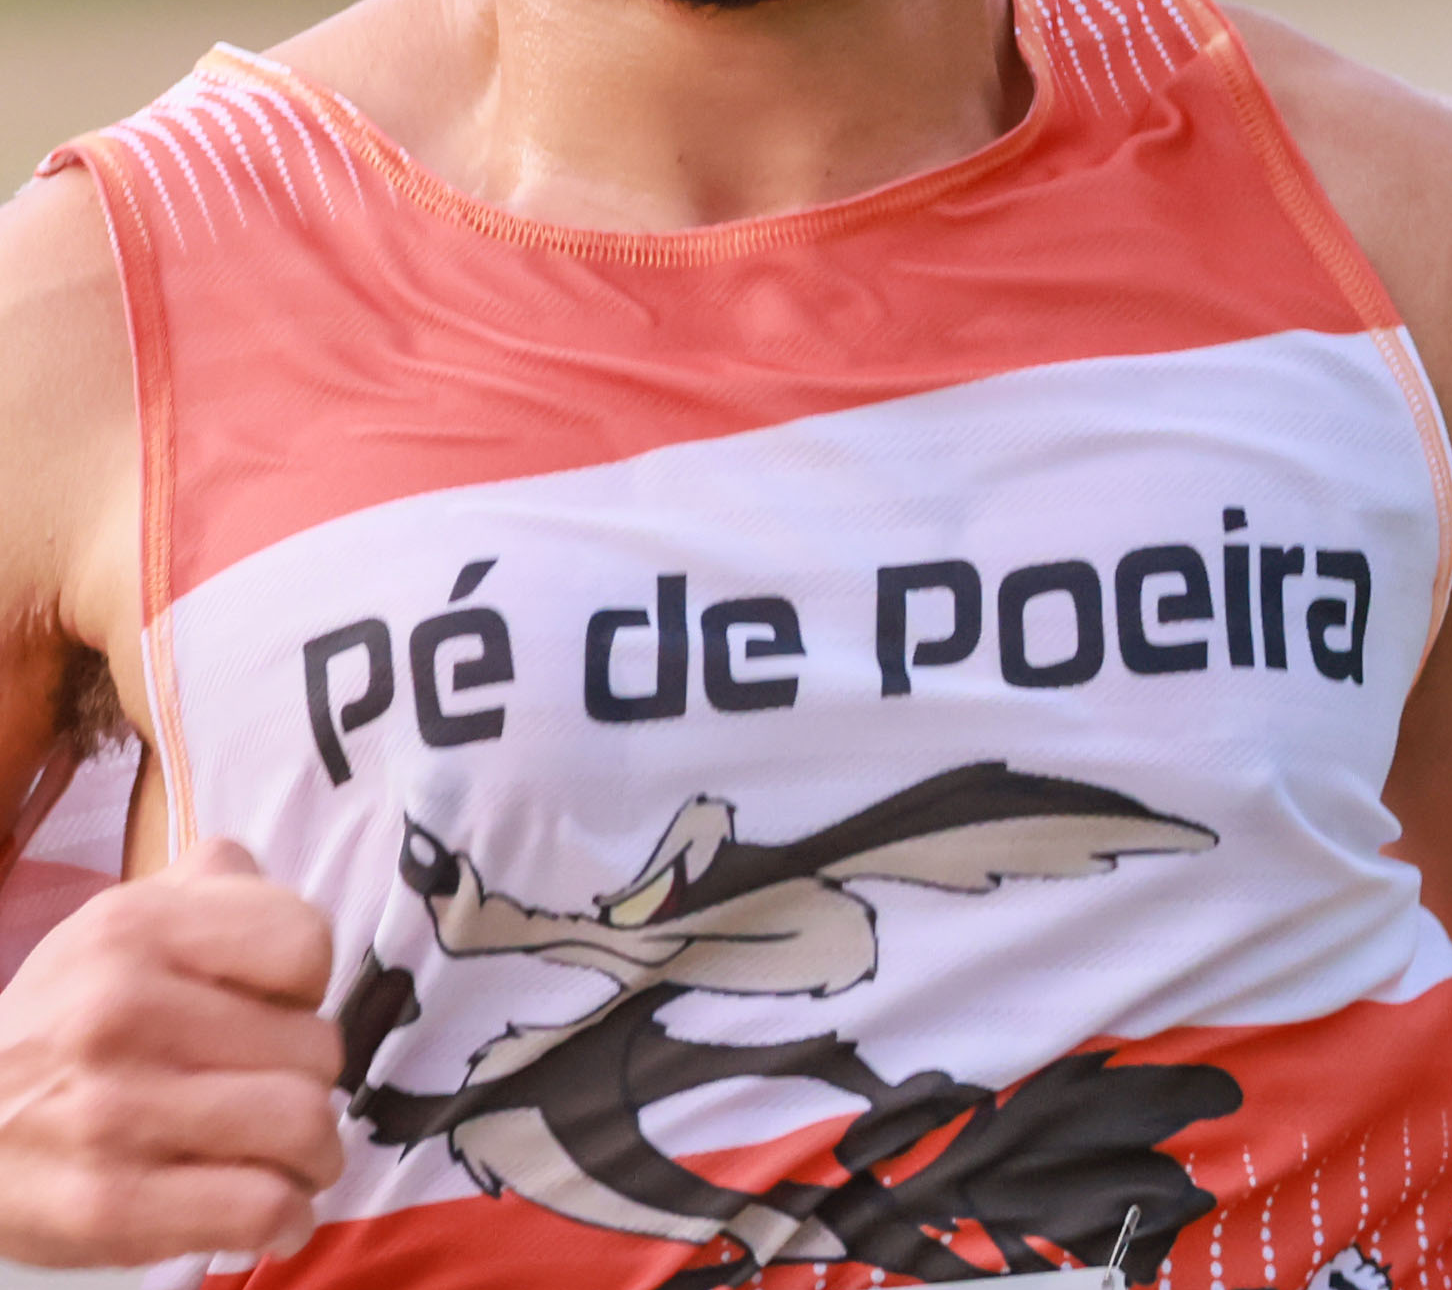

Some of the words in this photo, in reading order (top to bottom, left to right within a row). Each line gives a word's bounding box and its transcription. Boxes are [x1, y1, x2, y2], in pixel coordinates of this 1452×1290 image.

[302, 557, 515, 787] pé
[583, 573, 806, 724] de
[875, 506, 1371, 698] poeira
